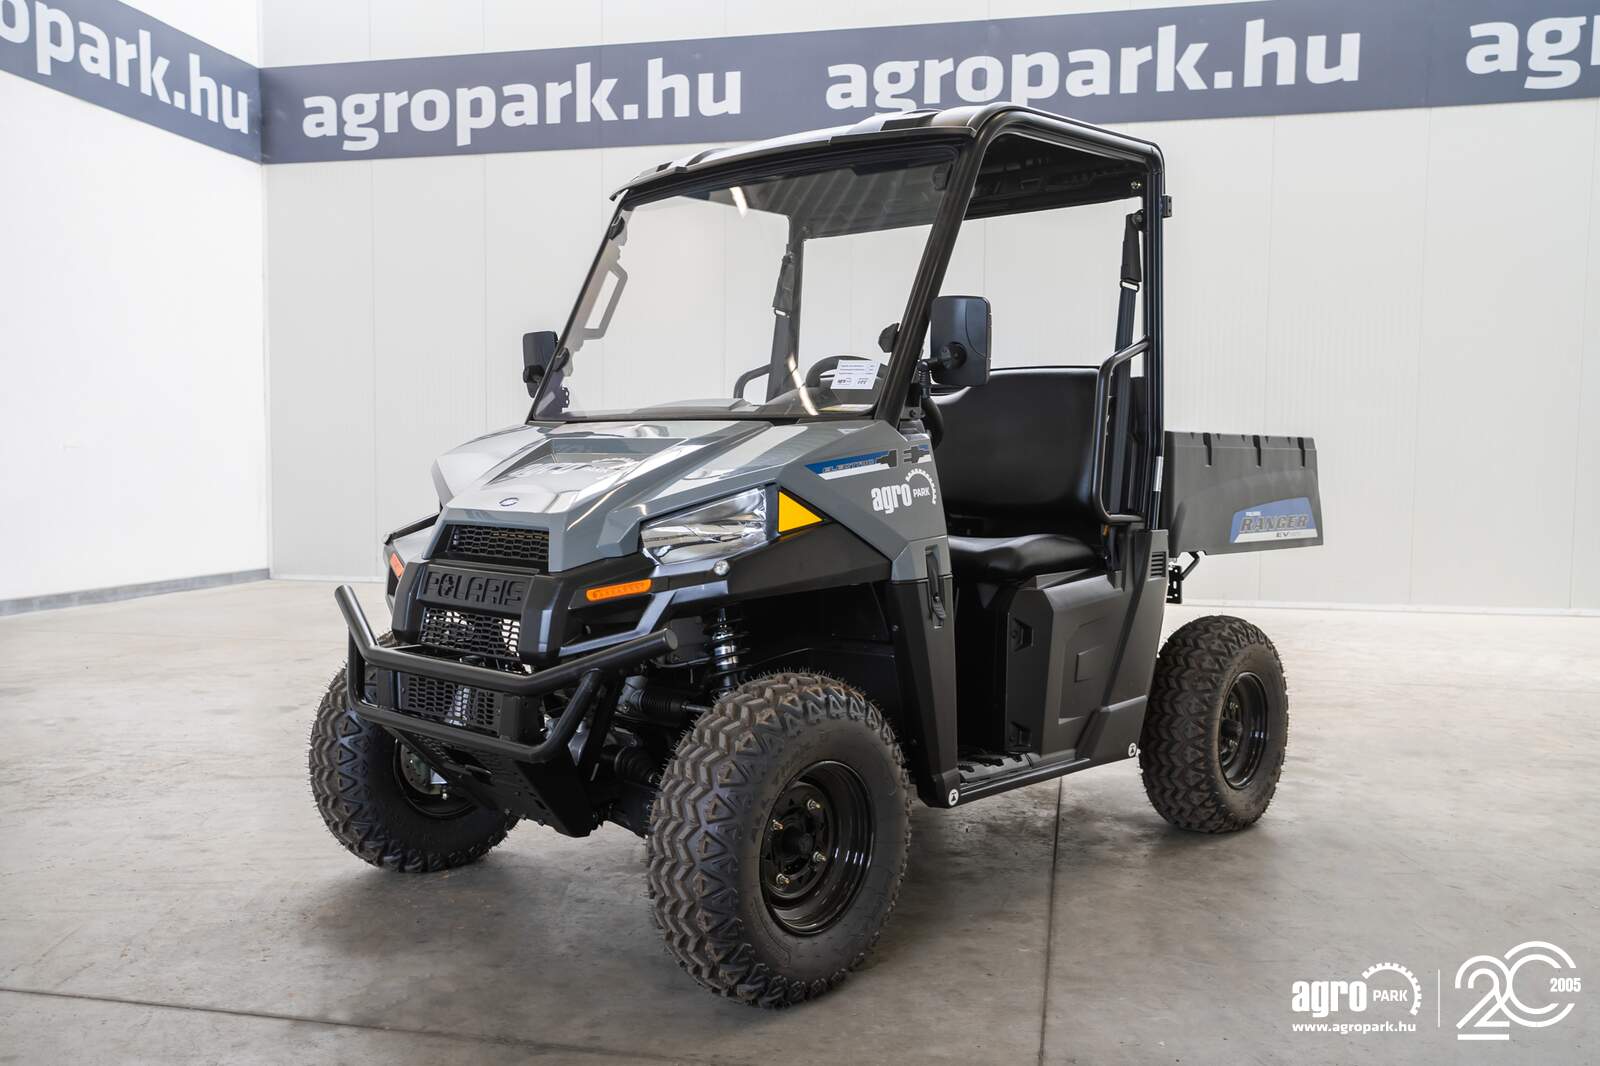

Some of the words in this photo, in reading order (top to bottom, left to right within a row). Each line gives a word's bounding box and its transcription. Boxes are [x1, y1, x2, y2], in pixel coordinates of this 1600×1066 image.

[826, 19, 1361, 117] agropark.hu
[302, 58, 742, 152] agropark.hu
[871, 483, 913, 514] agro
[912, 486, 931, 498] PARK
[1240, 513, 1309, 534] RANGER
[423, 570, 526, 606] POLARIS
